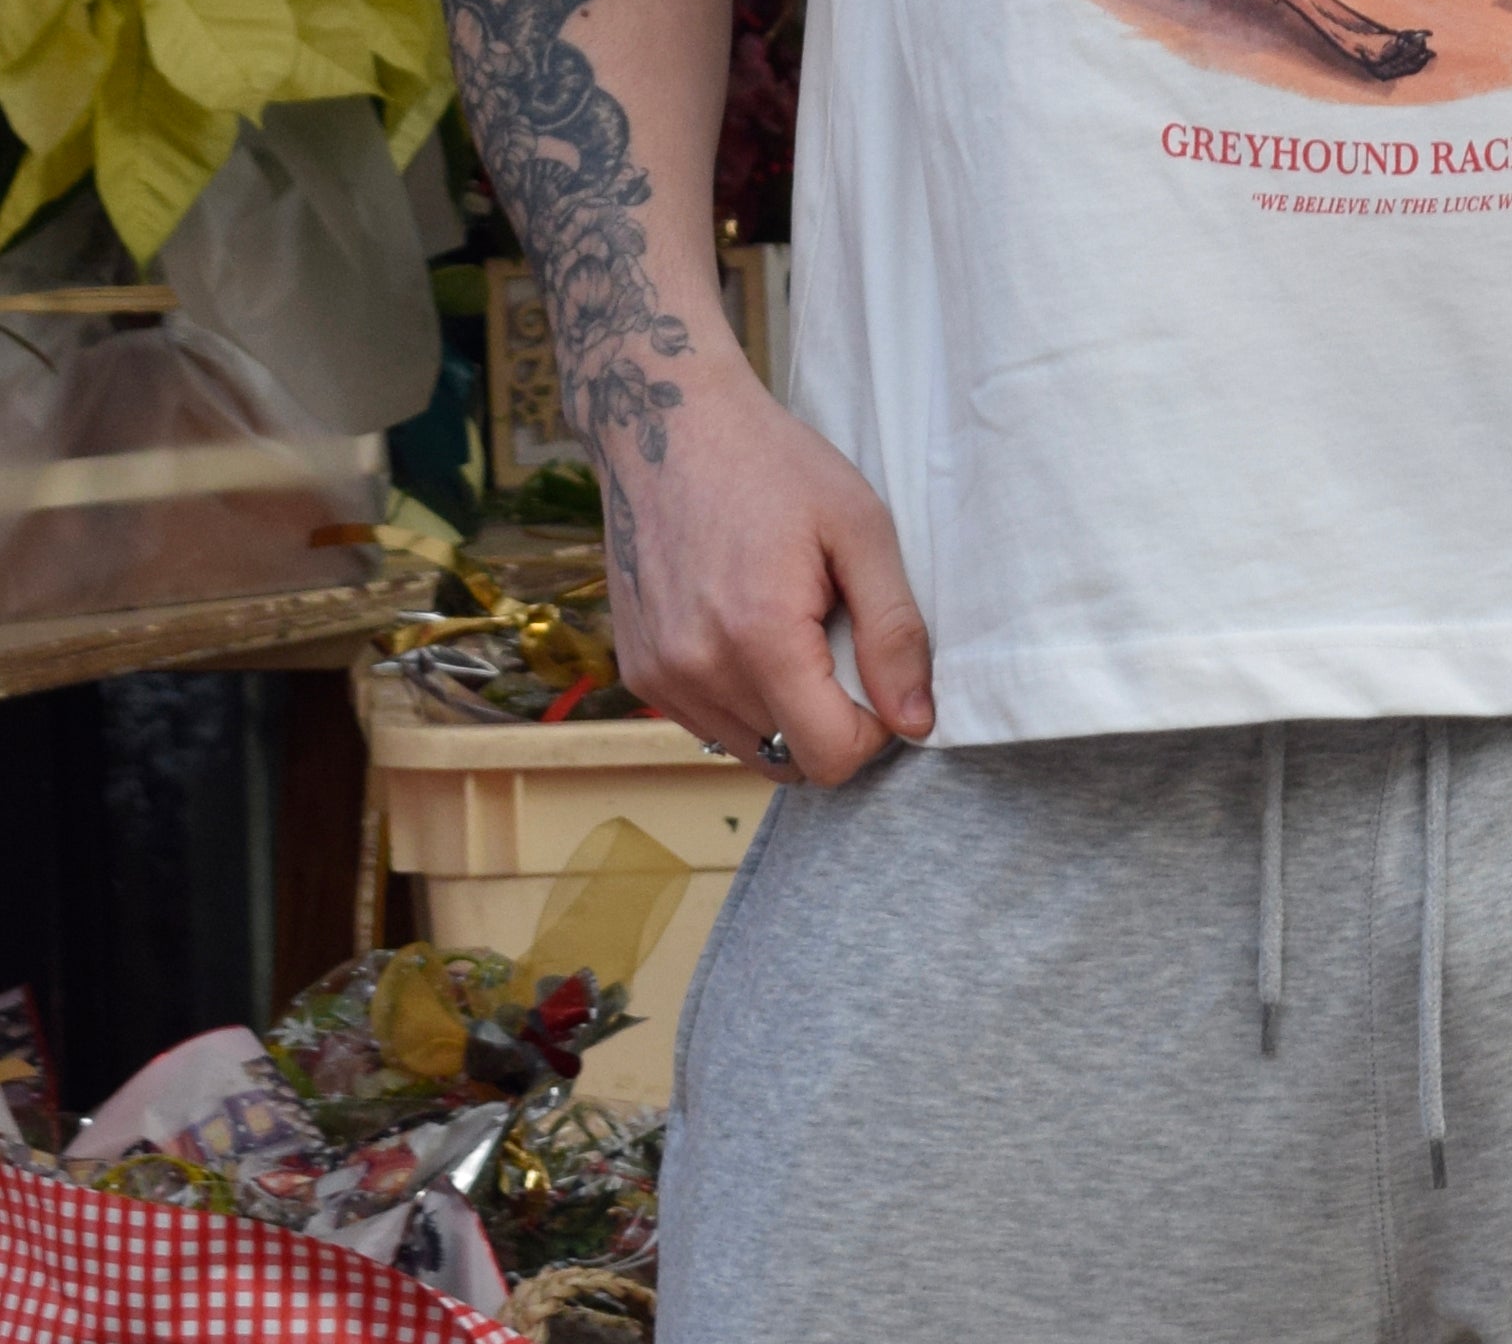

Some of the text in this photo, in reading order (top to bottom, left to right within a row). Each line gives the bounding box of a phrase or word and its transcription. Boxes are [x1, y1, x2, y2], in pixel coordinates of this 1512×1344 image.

[1161, 121, 1419, 176] GREYHOUND
[1293, 195, 1370, 216] BELIEVE
[1374, 197, 1397, 216] IN
[1401, 197, 1439, 214] THE
[1443, 194, 1495, 214] LUCK
